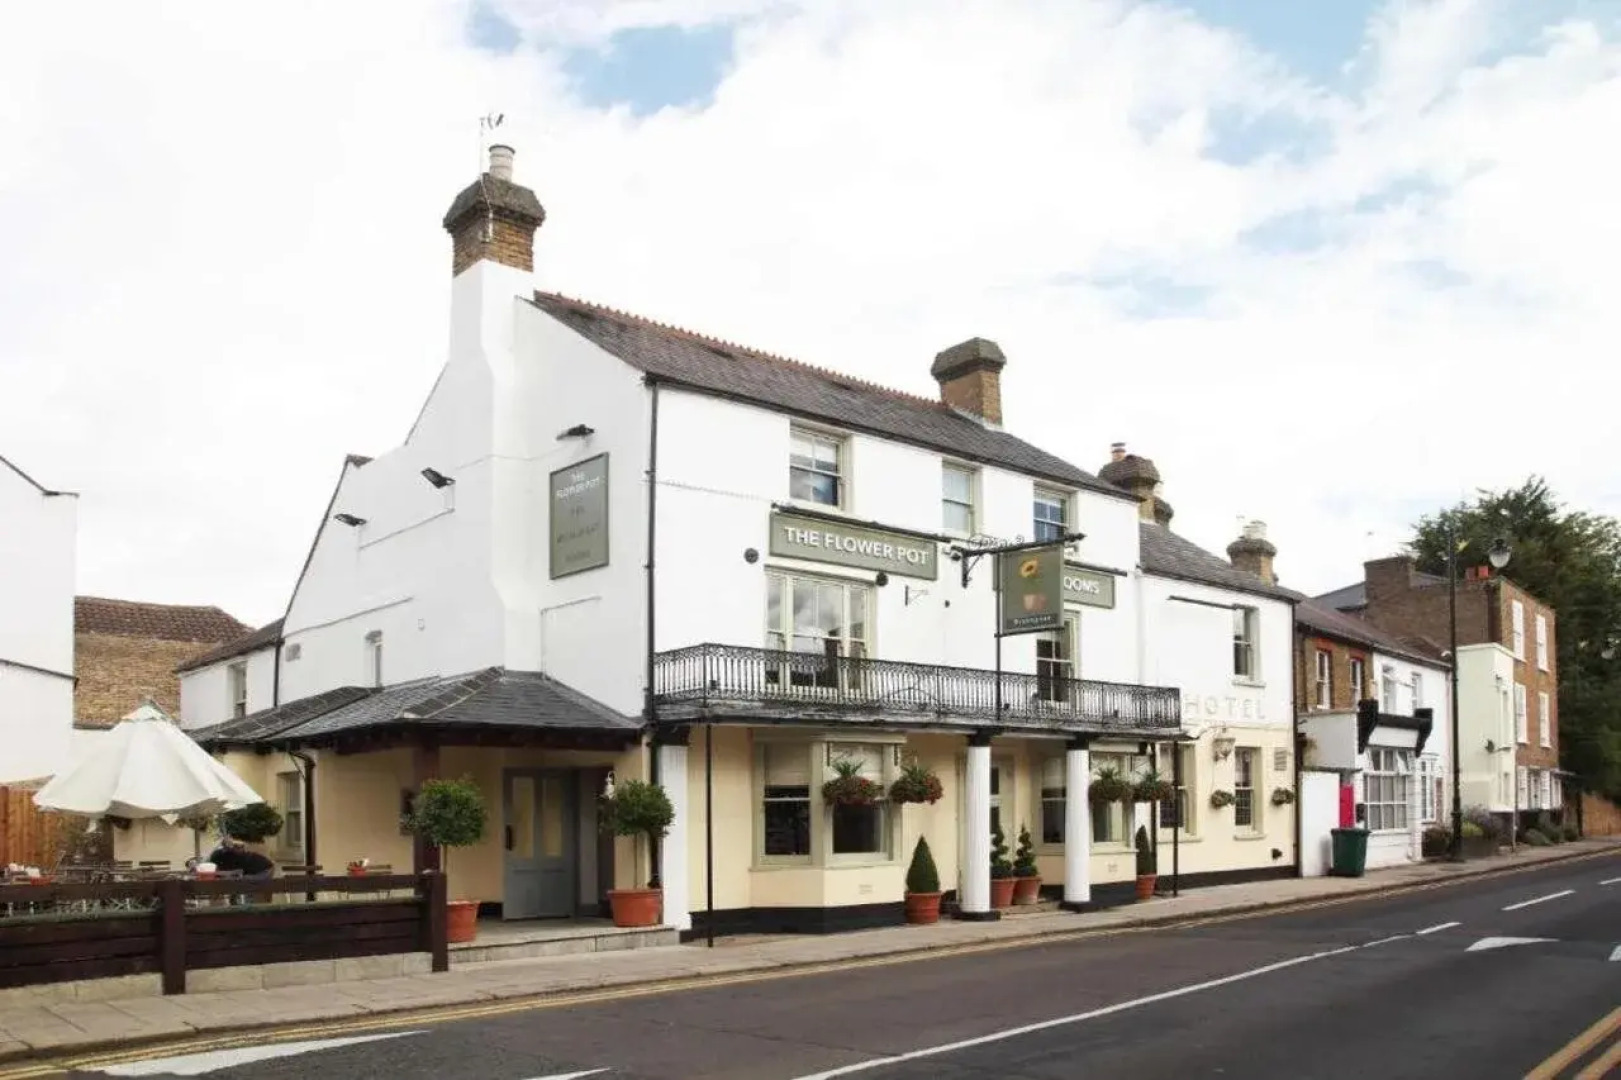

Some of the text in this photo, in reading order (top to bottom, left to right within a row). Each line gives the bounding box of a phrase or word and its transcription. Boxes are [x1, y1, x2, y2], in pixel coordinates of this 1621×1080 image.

[784, 526, 929, 565] THE FLOWER POT
[1063, 575, 1100, 595] OOMS
[1184, 693, 1266, 719] HOTEL
